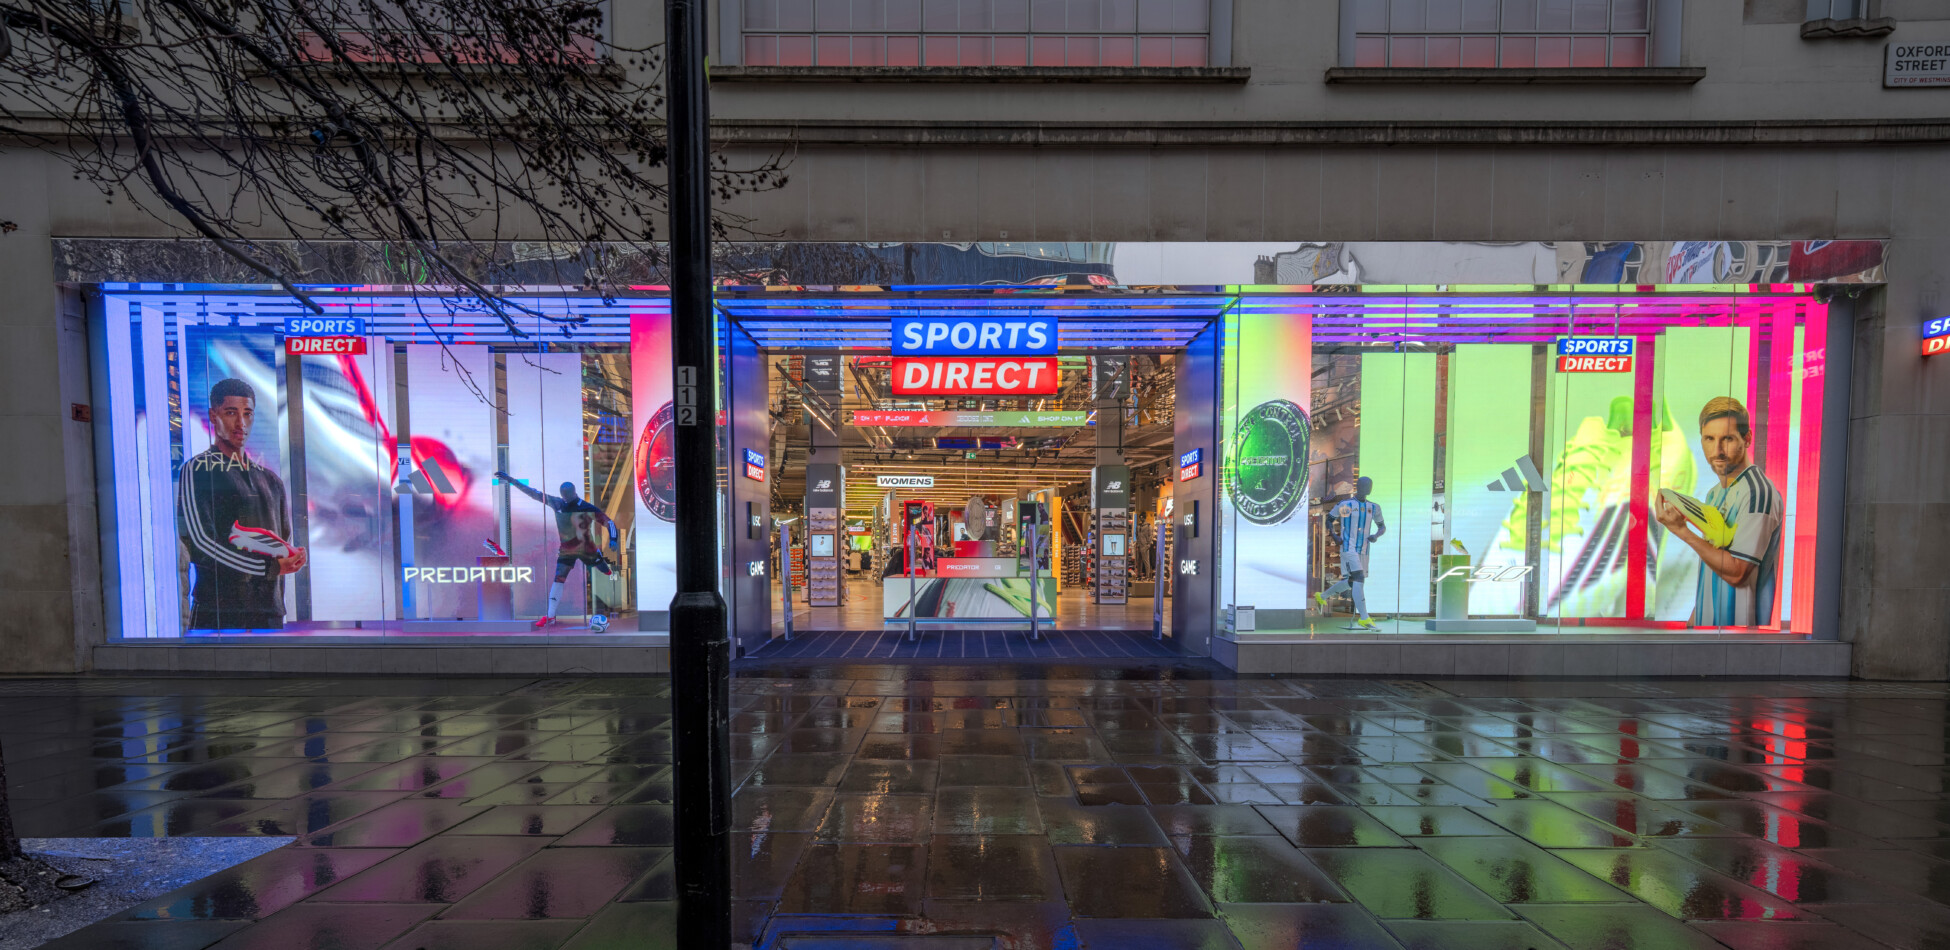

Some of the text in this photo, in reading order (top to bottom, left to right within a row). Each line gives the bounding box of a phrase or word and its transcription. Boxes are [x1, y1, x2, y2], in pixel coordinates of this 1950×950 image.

[1896, 45, 1950, 57] OXFORD
[1895, 59, 1947, 71] STREET
[290, 319, 356, 333] SPORTS
[902, 321, 1048, 349] SPORTS
[291, 338, 357, 352] DIRECT
[1564, 340, 1629, 353] SPORTS
[1564, 357, 1628, 371] DIRECT
[902, 361, 1048, 389] DIRECT
[748, 450, 764, 467] SPORTS
[1181, 450, 1198, 465] SPORTS
[748, 466, 764, 480] DIRECT
[1181, 466, 1198, 480] DIRECT
[880, 477, 932, 485] WOMENS
[752, 515, 761, 527] USC
[1184, 513, 1193, 526] USC
[750, 560, 764, 577] GAME
[1181, 559, 1197, 575] GAME
[1436, 565, 1534, 582] F50
[404, 567, 532, 583] PREDATOR
